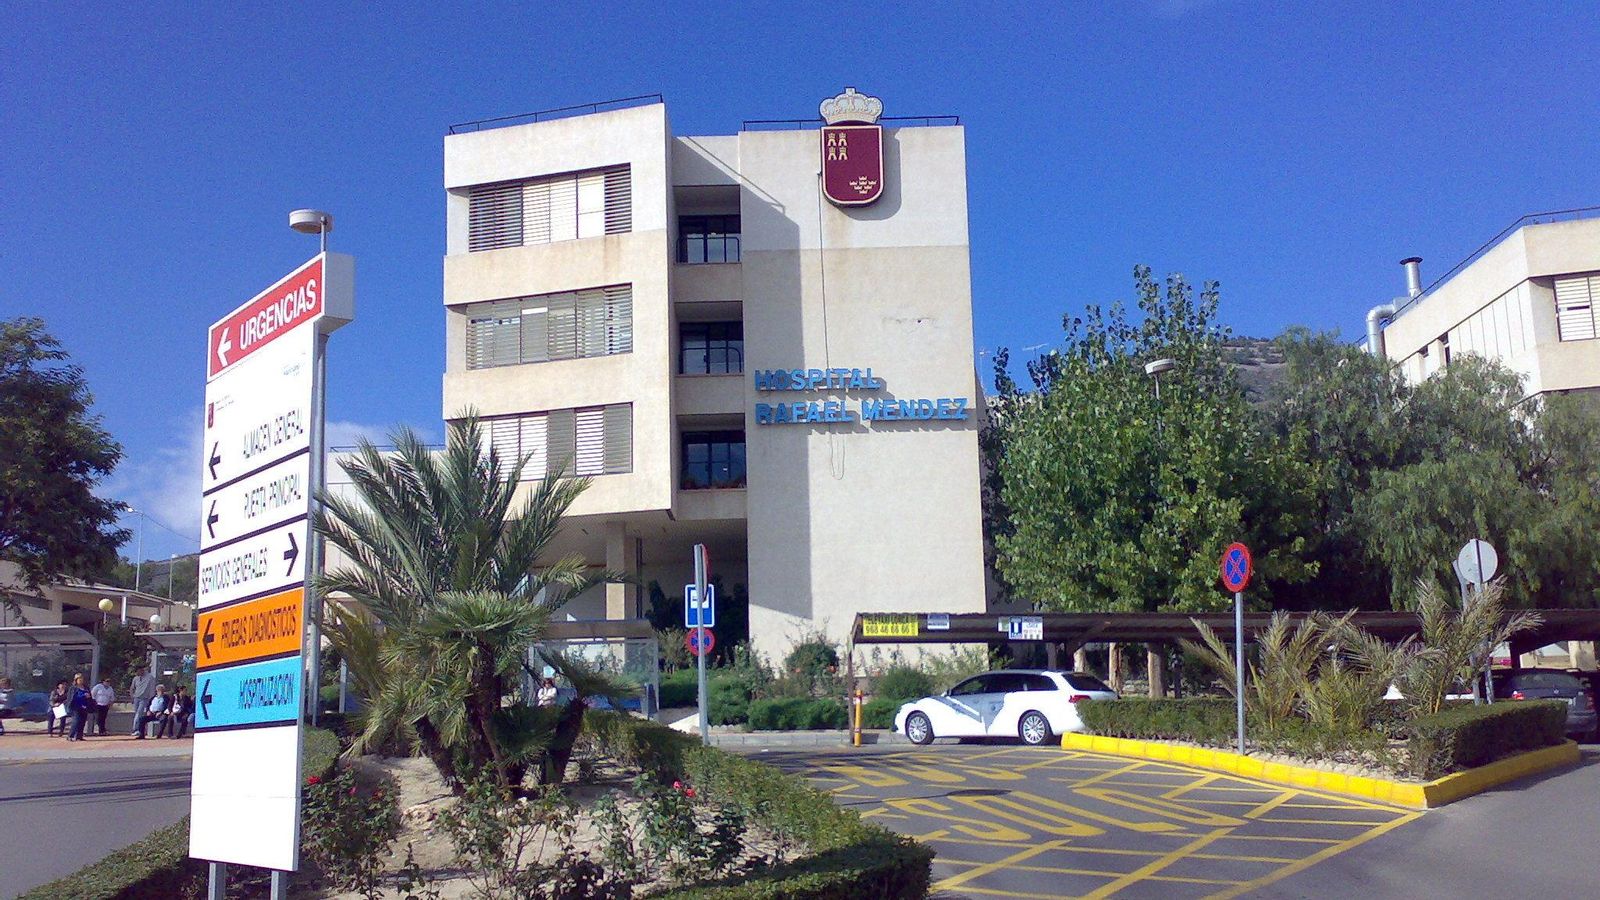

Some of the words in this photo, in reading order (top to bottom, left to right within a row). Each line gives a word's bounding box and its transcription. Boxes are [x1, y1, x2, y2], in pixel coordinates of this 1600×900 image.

[240, 278, 317, 350] URGENCIAS
[754, 367, 881, 391] HOSPITAL
[273, 407, 304, 446] GENERAL
[755, 400, 854, 425] RAFAEL
[861, 397, 970, 422] MENDEZ
[243, 485, 268, 519] PUERTA
[268, 472, 302, 508] PRINCIPAL
[201, 560, 231, 595] SERVICIOS
[232, 546, 268, 585] GENERALES
[221, 615, 248, 649] PRUEBAS
[809, 755, 1027, 787] BUS
[882, 788, 1250, 841] SOLO
